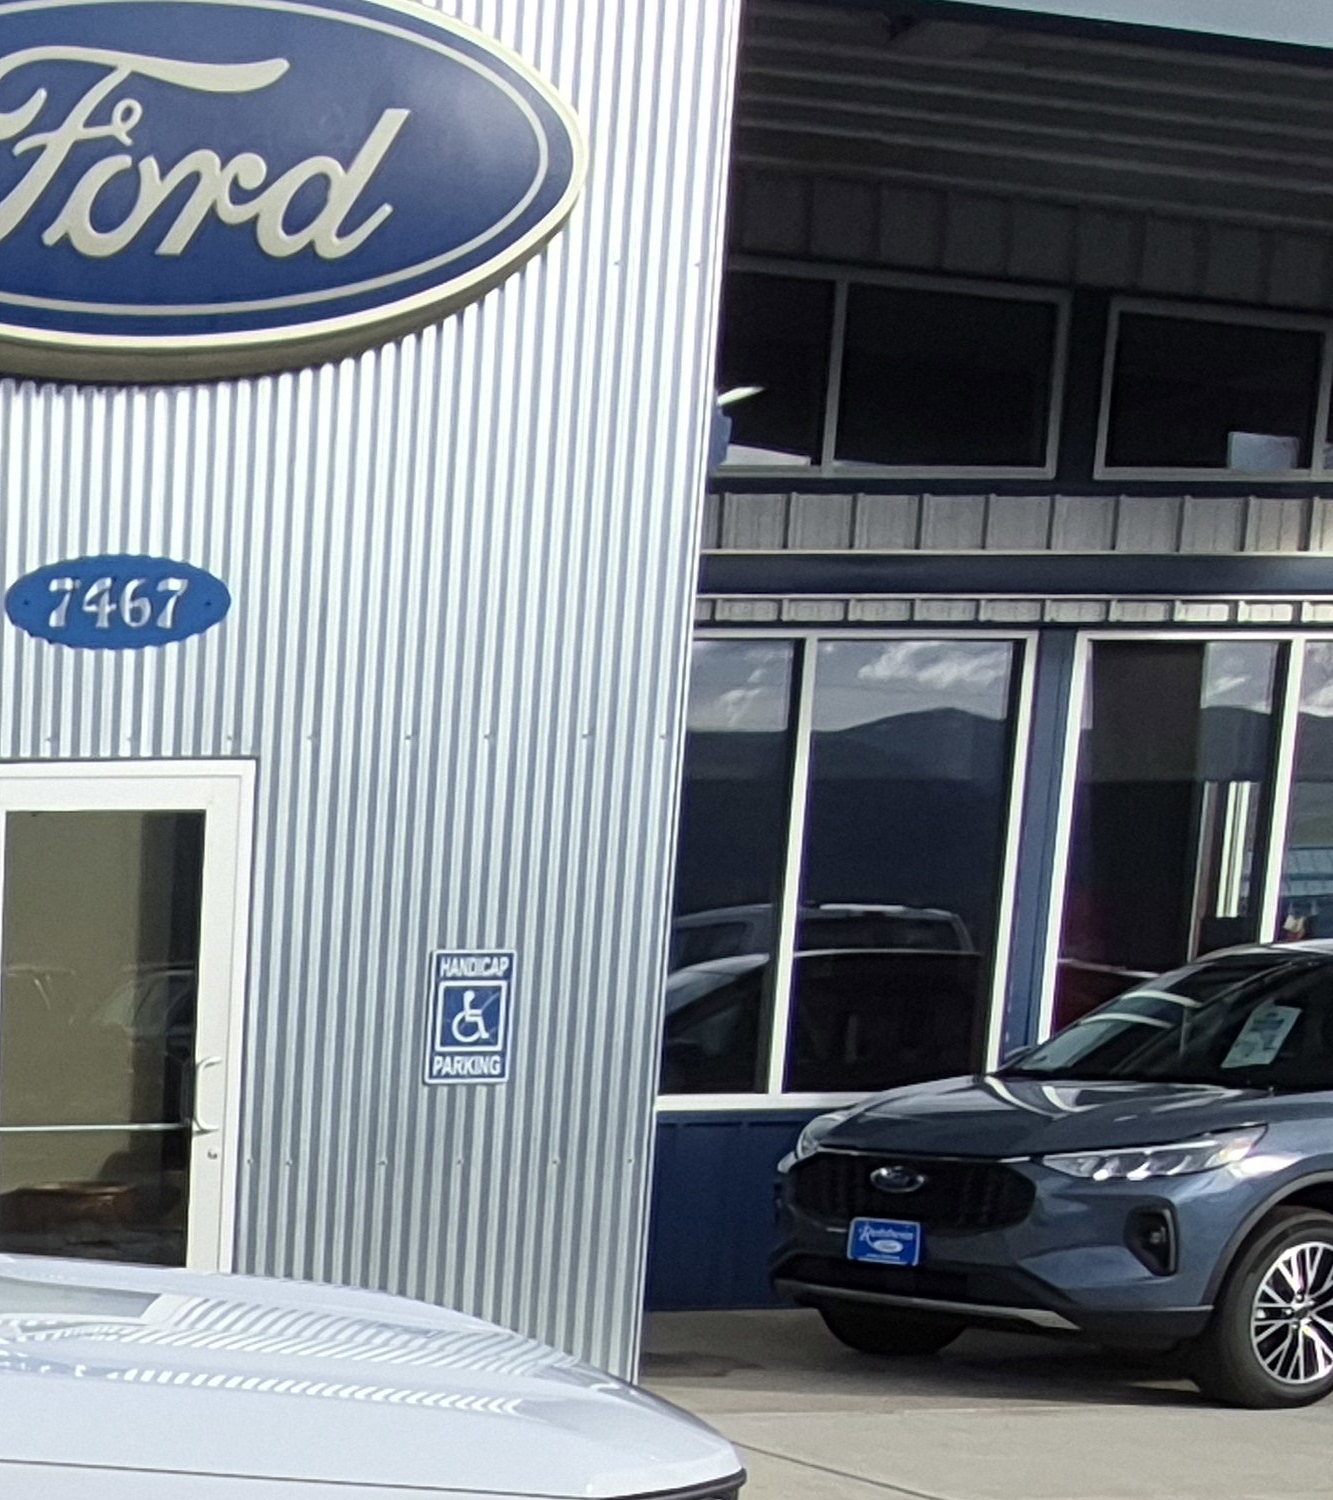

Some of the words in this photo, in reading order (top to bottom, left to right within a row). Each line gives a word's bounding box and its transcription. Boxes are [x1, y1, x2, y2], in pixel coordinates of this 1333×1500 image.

[48, 577, 189, 628] 7467
[440, 957, 509, 977] HANDICAP
[433, 1056, 501, 1076] PARKING
